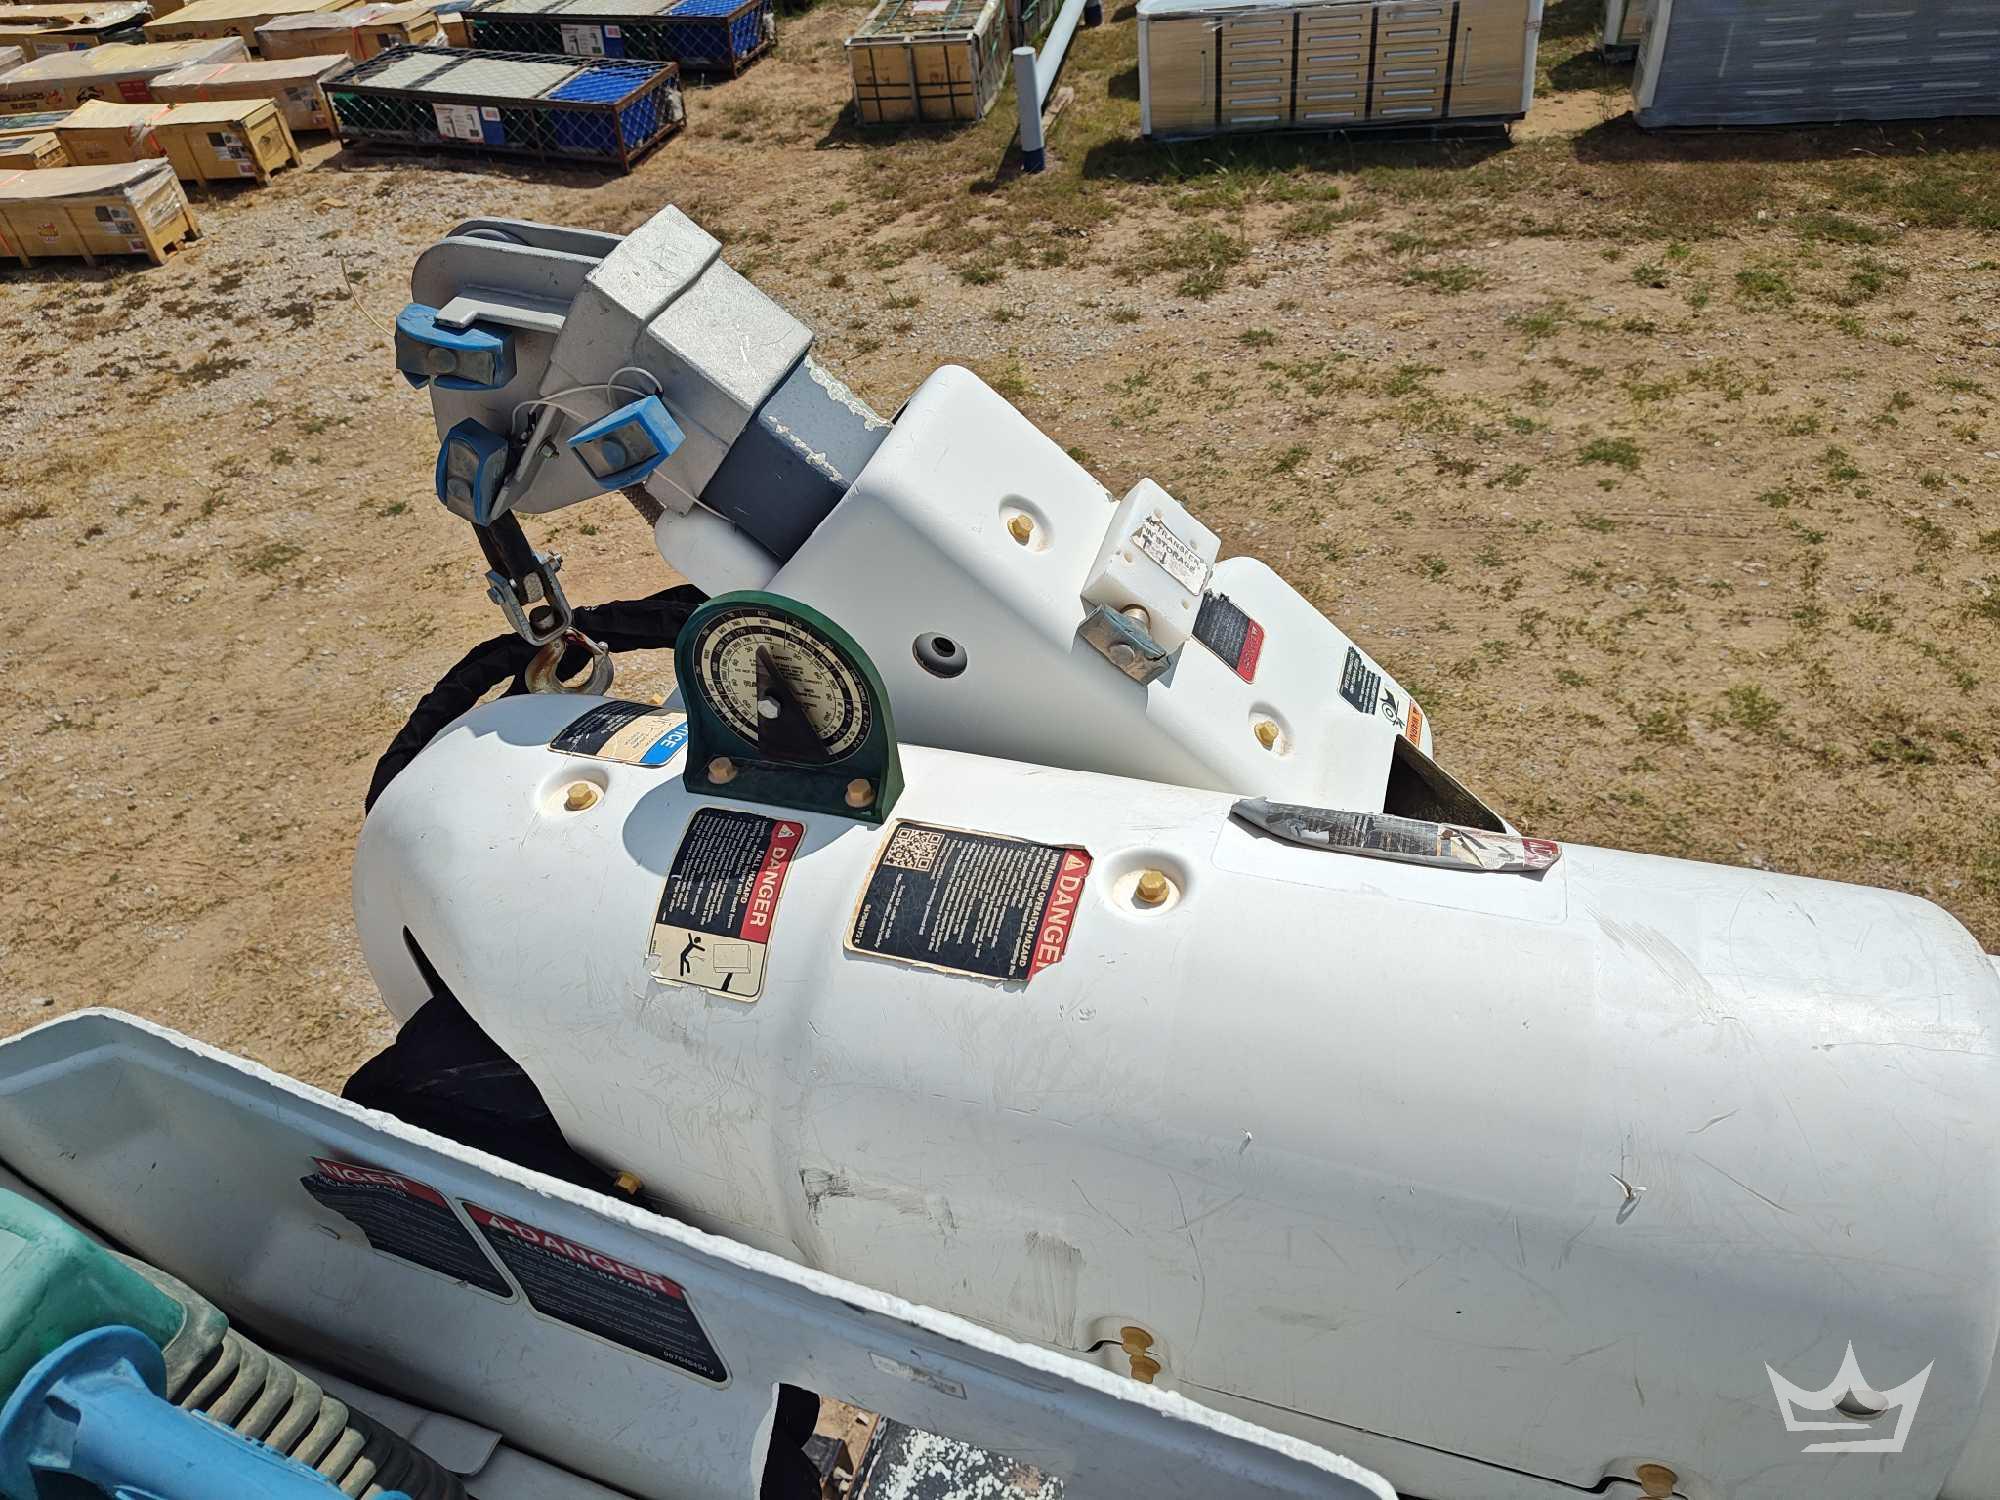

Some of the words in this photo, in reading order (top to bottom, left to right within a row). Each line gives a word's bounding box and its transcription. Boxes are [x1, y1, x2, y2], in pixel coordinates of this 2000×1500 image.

[752, 850, 764, 868] FALL
[1041, 853, 1060, 890] UNTRAINED
[750, 846, 786, 926] DANGER
[1028, 891, 1046, 932] OPERATOR
[1019, 932, 1034, 967] HAZARD
[319, 1161, 409, 1190] NGER
[508, 1235, 595, 1272] ELECTRICAL
[515, 1224, 668, 1293] DANGER
